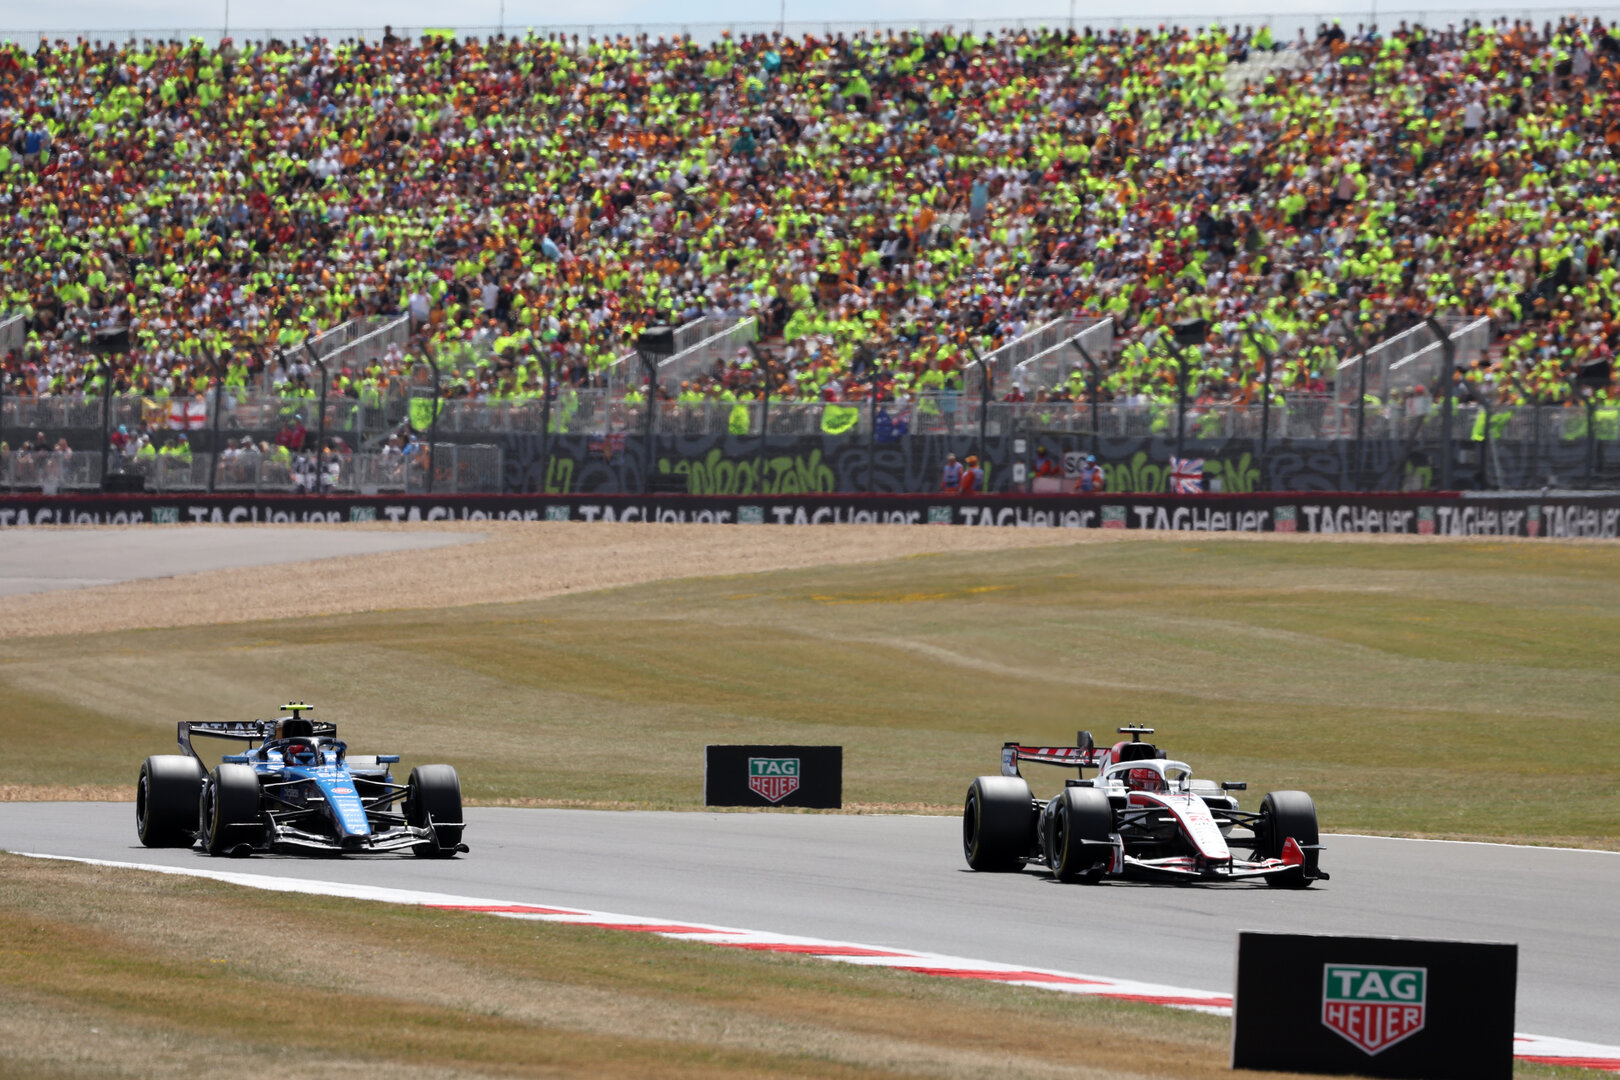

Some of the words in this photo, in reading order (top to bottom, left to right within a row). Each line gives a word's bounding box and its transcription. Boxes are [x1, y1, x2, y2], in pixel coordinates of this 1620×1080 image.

[753, 761, 795, 774] TAG
[752, 778, 796, 798] HEUER
[1332, 970, 1416, 999] TAG
[1328, 1004, 1419, 1047] HEUER
